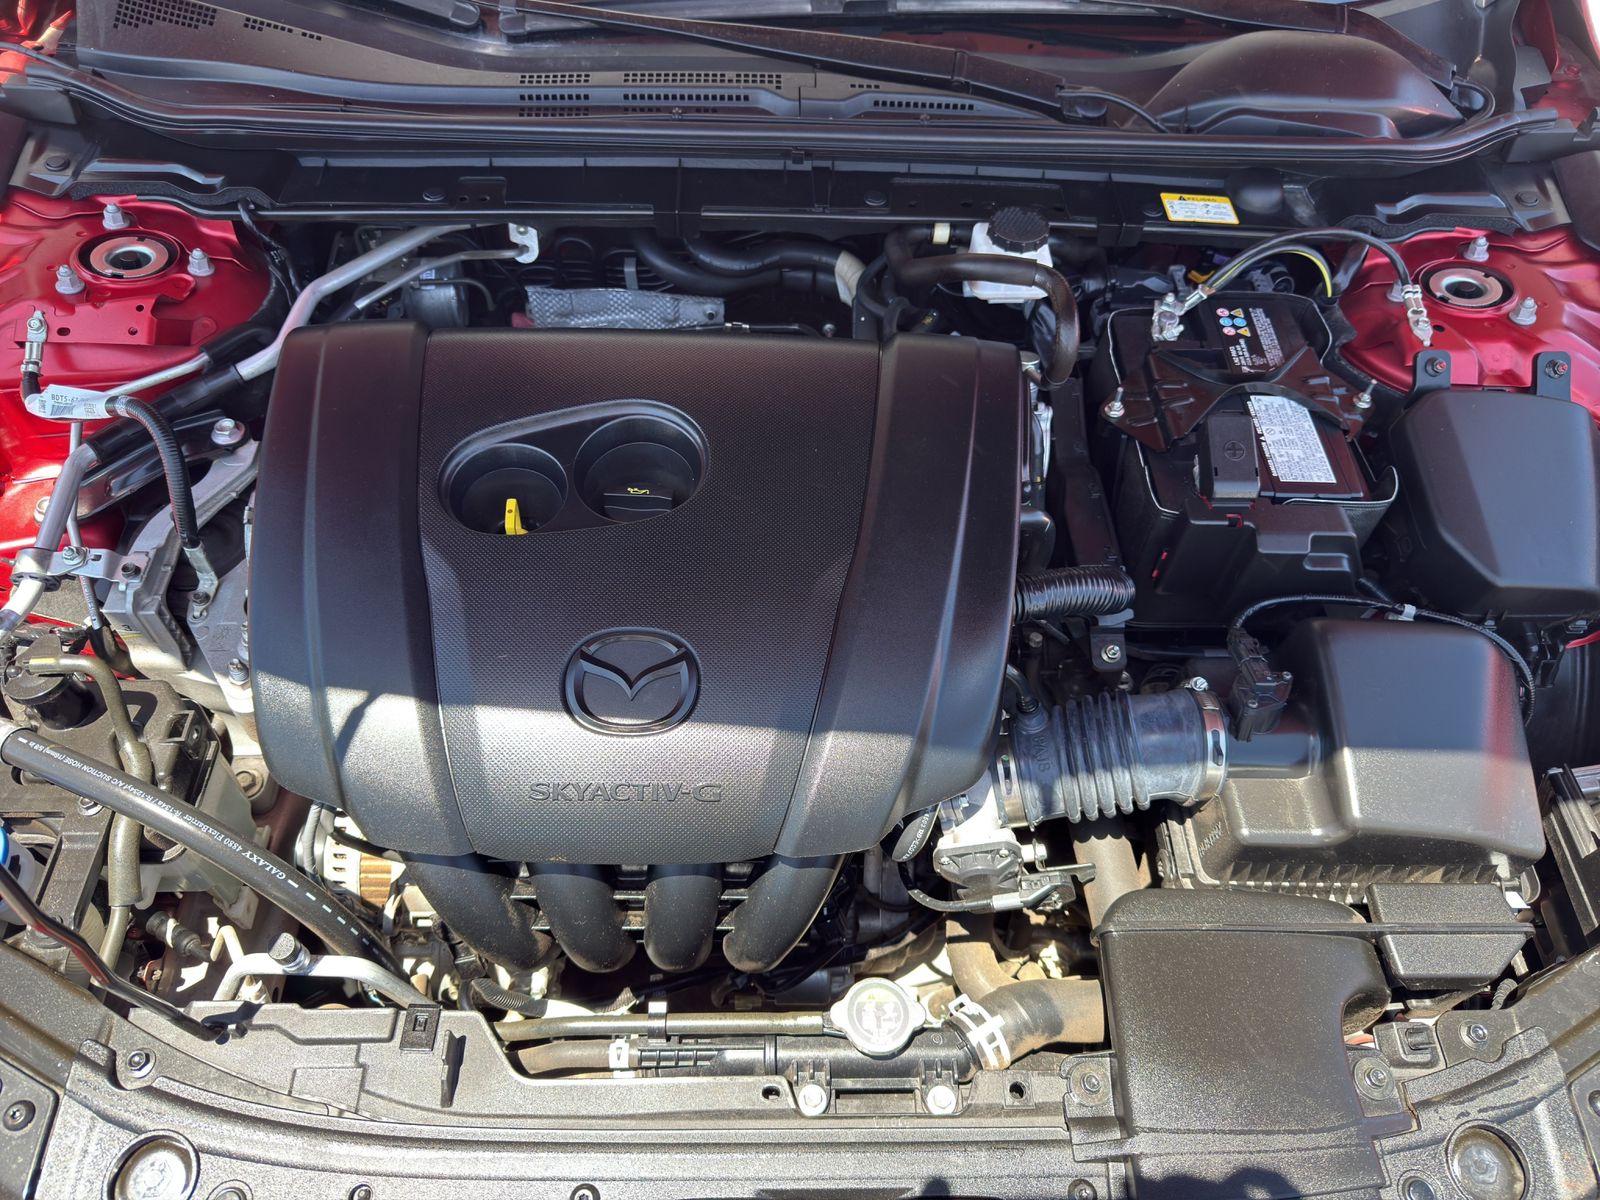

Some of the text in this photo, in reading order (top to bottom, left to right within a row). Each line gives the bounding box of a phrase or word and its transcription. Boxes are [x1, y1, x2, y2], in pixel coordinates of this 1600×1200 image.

[63, 756, 83, 768] HOSE
[81, 765, 112, 781] SUCTION
[111, 778, 124, 787] A/C
[123, 783, 153, 801] R-1234yf
[528, 781, 722, 803] SKYACTIV-G
[157, 800, 182, 816] R-134a
[183, 814, 225, 841] FlexBarrier
[222, 836, 243, 853] 4880
[241, 848, 286, 880] GALAXY
